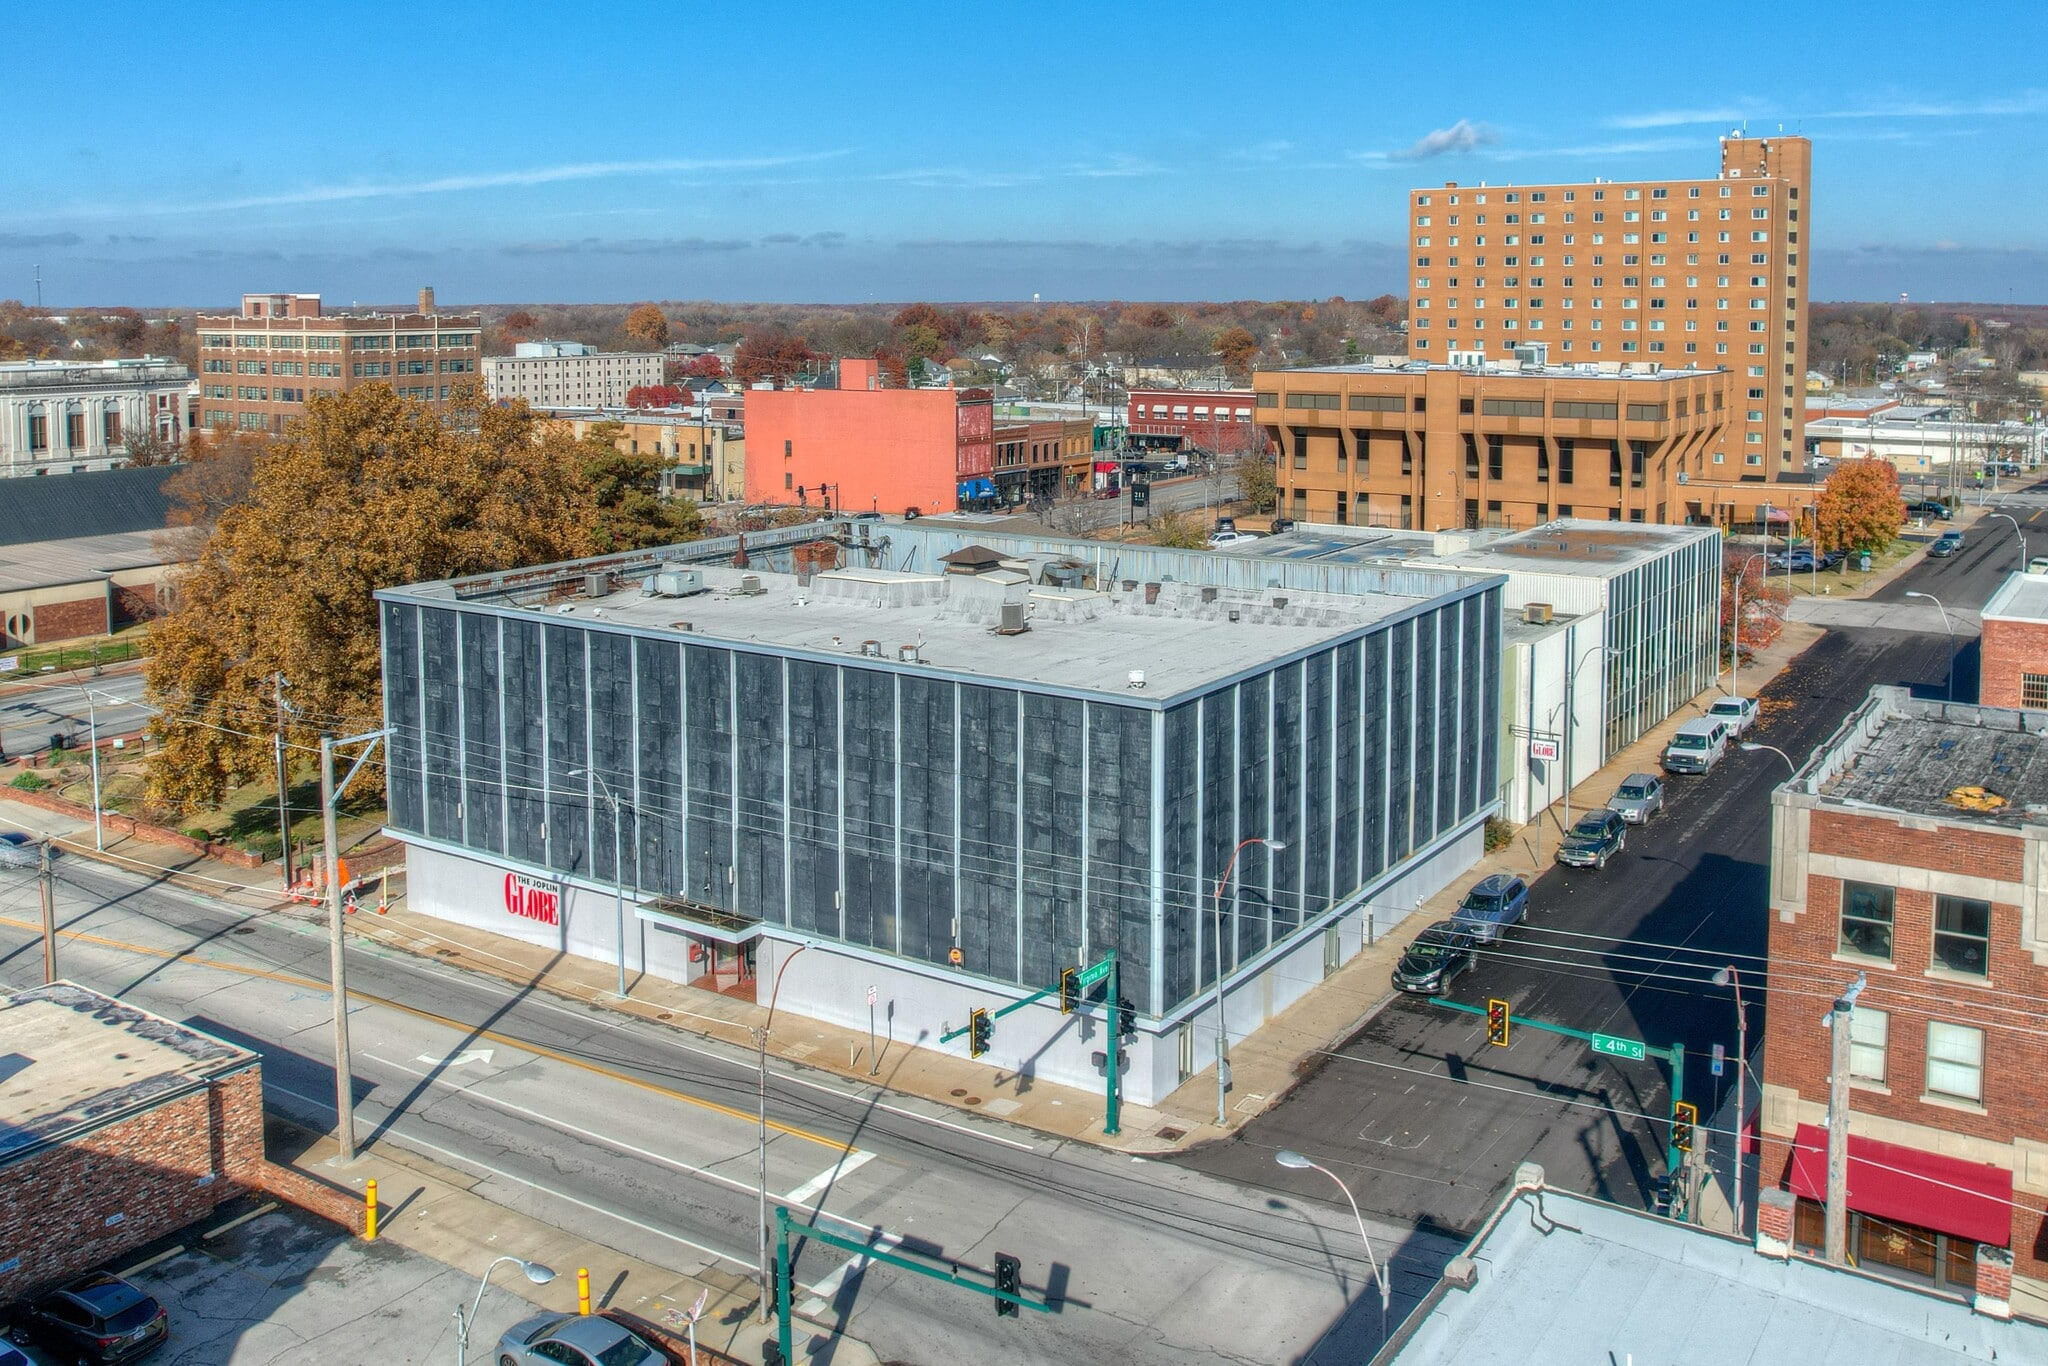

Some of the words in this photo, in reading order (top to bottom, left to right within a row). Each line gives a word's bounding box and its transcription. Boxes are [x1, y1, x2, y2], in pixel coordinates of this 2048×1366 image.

[1533, 743, 1556, 757] GLOBE
[517, 876, 530, 884] THE
[533, 881, 558, 892] JOPLIN
[504, 873, 559, 926] GLOBE
[1594, 1040, 1600, 1049] E
[1606, 1040, 1627, 1052] 4th
[1631, 1047, 1642, 1058] St
